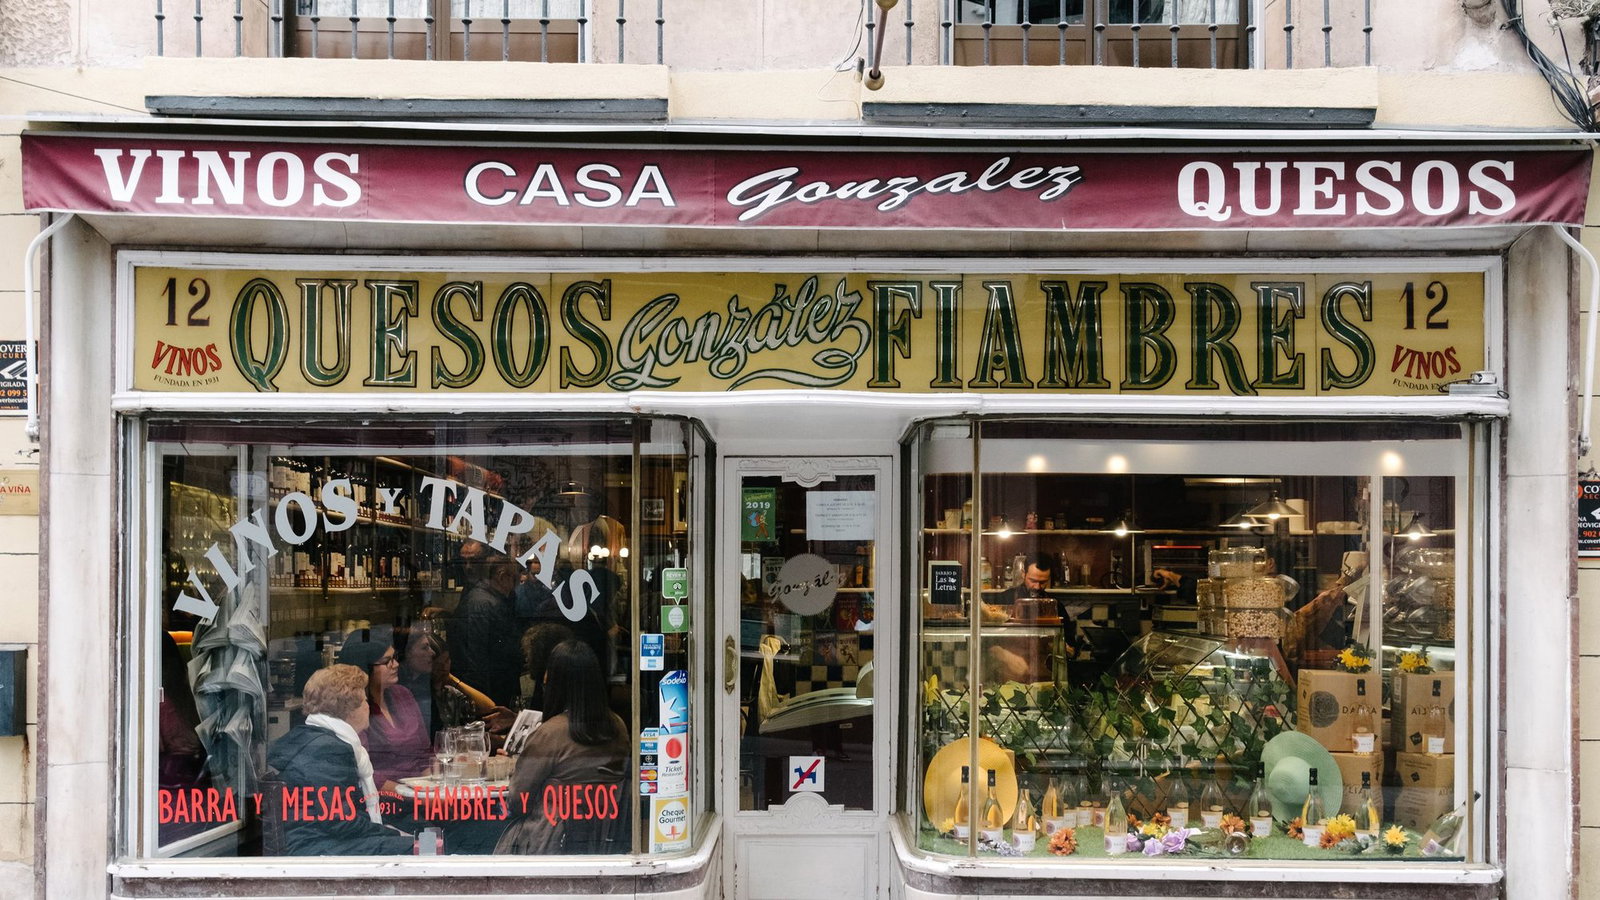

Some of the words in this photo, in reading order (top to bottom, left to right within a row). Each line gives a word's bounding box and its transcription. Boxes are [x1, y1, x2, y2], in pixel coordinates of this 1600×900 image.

[94, 148, 362, 207] VINOS
[464, 160, 677, 208] CASA
[727, 156, 1082, 221] Gonzalez
[1177, 160, 1516, 221] QUESOS
[161, 277, 212, 326] 12
[1399, 281, 1449, 330] 12
[230, 277, 612, 392] QUESOS
[605, 276, 870, 391] González
[867, 280, 1376, 396] FIAMBRES
[151, 340, 222, 376] VINOS
[1391, 344, 1461, 379] VINOS
[154, 374, 190, 387] FUNDADA
[204, 376, 220, 385] 1931
[1393, 378, 1429, 391] FUNDADA
[8, 484, 31, 493] VIÑA
[746, 501, 770, 509] 2019
[1584, 485, 1600, 493] CO
[172, 477, 359, 624] VINOS
[380, 487, 403, 515] Y
[419, 475, 600, 622] TAPAS
[935, 575, 947, 583] Las
[935, 582, 957, 590] Letras
[665, 765, 683, 773] Ticket
[158, 786, 238, 824] BARRA
[253, 792, 263, 815] Y
[281, 785, 356, 823] MESAS
[413, 785, 509, 822] FIAMBRES
[520, 792, 530, 815] Y
[543, 784, 619, 827] QUESOS
[658, 815, 686, 824] Gourmet
[661, 809, 685, 817] Cheque
